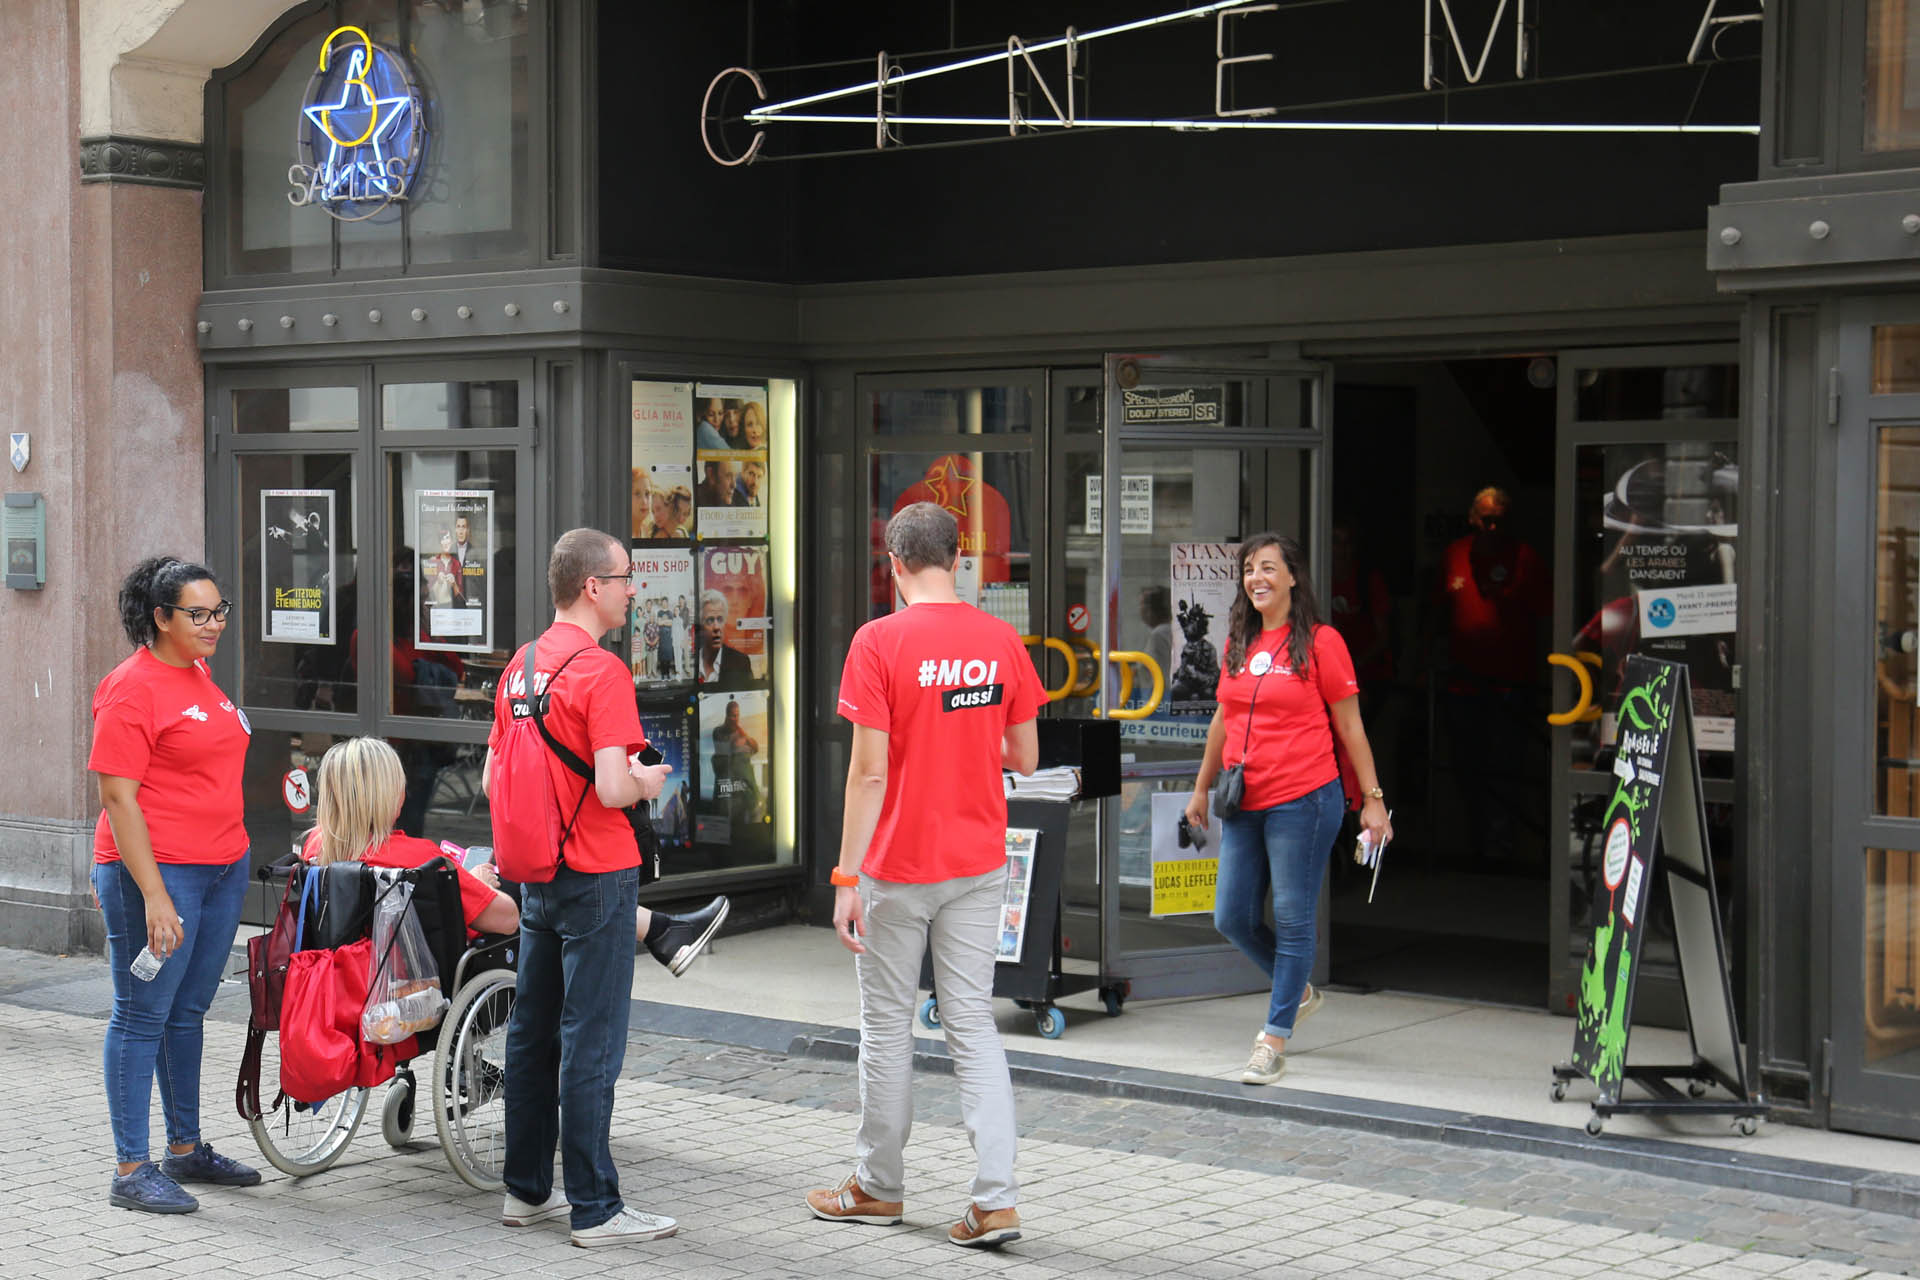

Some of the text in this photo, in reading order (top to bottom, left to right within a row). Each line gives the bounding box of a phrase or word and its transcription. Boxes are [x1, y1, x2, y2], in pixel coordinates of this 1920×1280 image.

[288, 157, 408, 206] SALLES
[633, 409, 683, 422] GLIA MIA
[1129, 408, 1189, 418] DOLBY STEREO
[1196, 404, 1216, 418] SR
[1177, 543, 1228, 560] STAN
[1619, 546, 1633, 556] AU
[1636, 546, 1668, 556] TEMPS
[631, 560, 689, 573] AMEN SHOP
[710, 552, 761, 575] GUY
[1627, 558, 1687, 567] LES ARABES
[1630, 570, 1687, 580] DANSAIENT
[302, 598, 322, 609] DAHO
[917, 659, 998, 687] #MOI
[951, 685, 994, 708] aussi
[647, 729, 681, 739] UPLE
[1120, 722, 1208, 740] yez curieux
[1154, 875, 1181, 890] LUCAS
